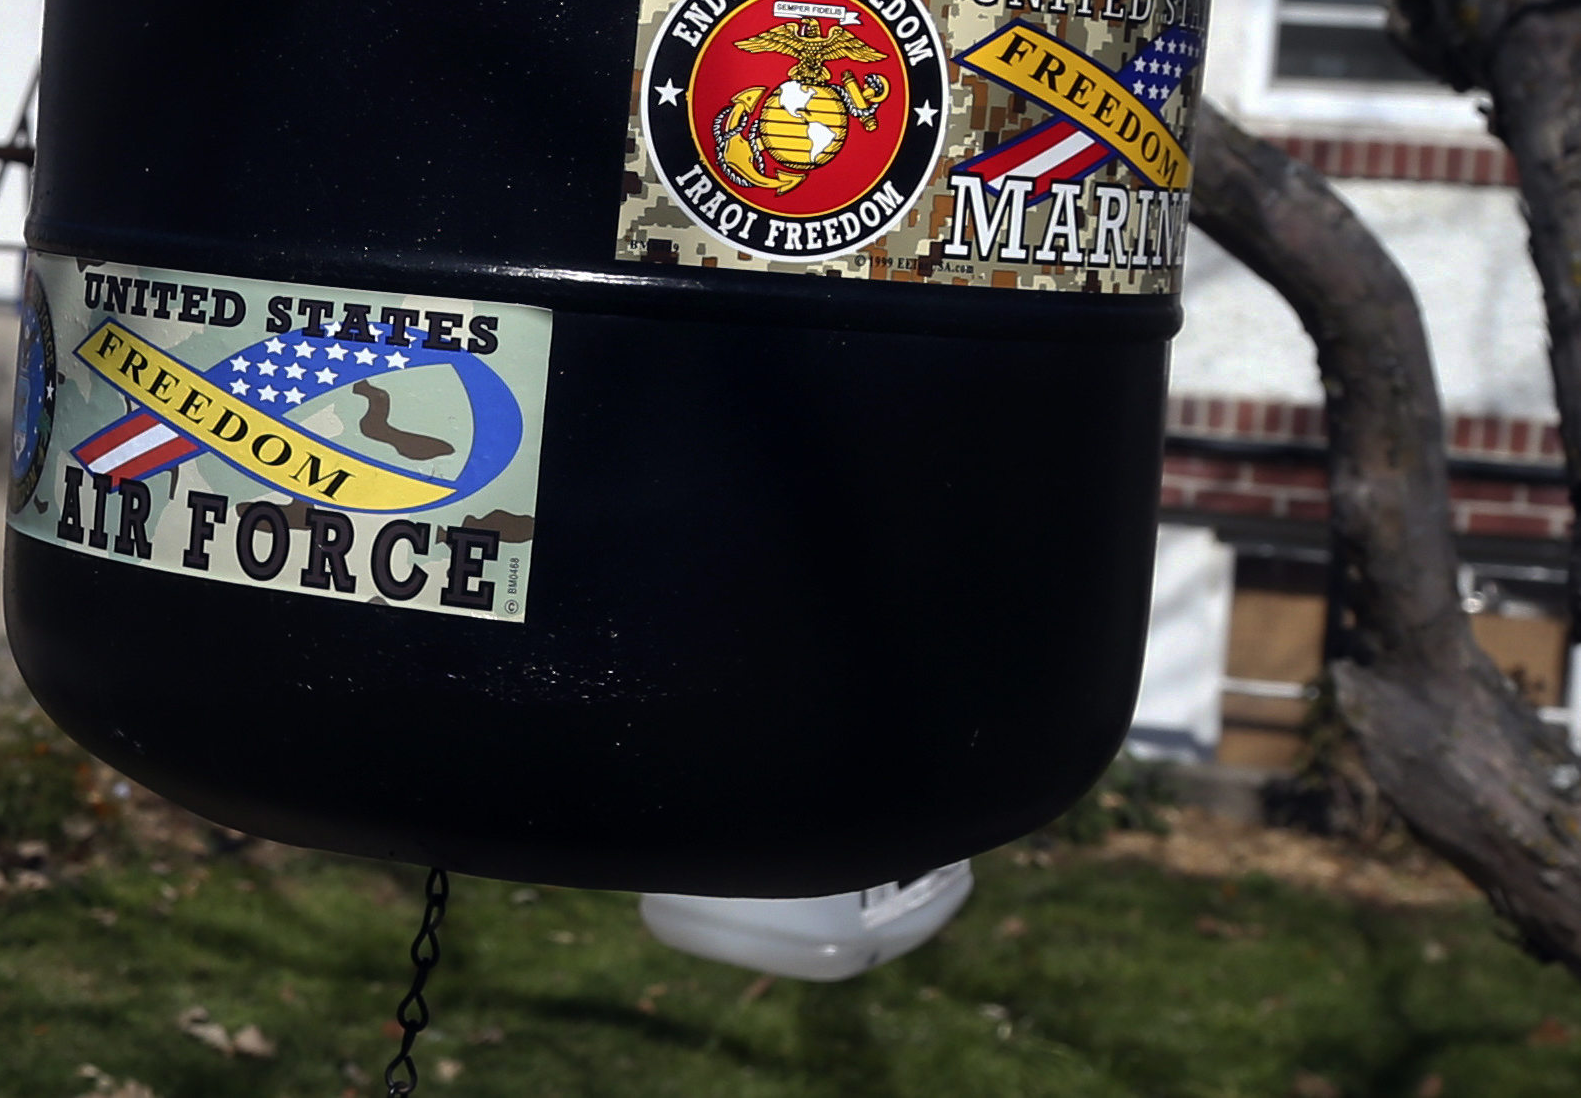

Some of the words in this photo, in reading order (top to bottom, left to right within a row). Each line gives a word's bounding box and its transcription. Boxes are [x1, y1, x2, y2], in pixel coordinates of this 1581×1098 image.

[777, 3, 810, 13] SEMPER
[812, 6, 842, 16] FIDELIS
[995, 33, 1179, 189] FREEDOM
[675, 164, 758, 240] IRAQI
[764, 181, 904, 252] FREEDOM
[84, 272, 246, 327] UNITED
[266, 296, 498, 354] STATES
[96, 327, 356, 502] FREEDOM
[57, 466, 152, 560] AIR
[182, 490, 500, 611] FORCE
[508, 557, 520, 594] BM0468
